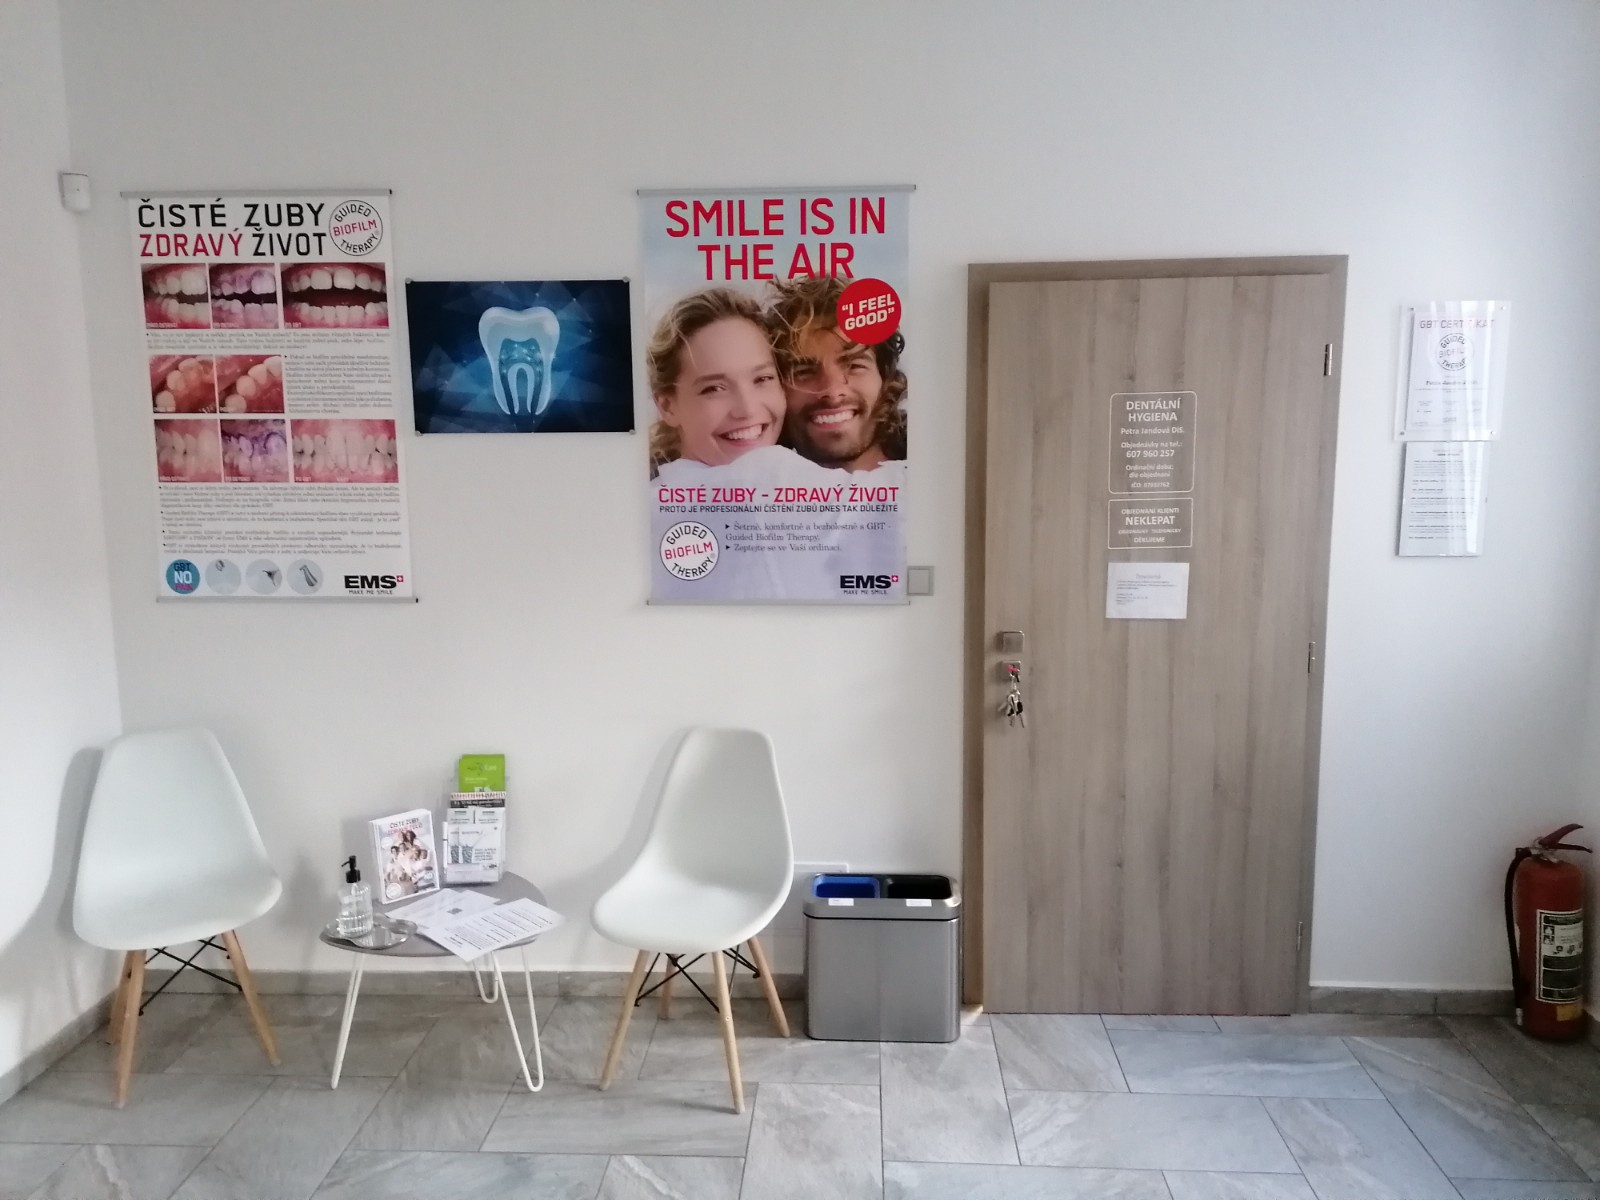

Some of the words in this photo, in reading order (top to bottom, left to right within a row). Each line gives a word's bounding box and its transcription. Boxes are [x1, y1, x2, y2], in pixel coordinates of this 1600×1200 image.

[138, 198, 227, 228] ČISTÉ
[243, 203, 325, 227] ZUBY
[334, 203, 372, 222] GUIDED
[665, 199, 785, 238] SMILE
[800, 197, 835, 236] IS
[849, 197, 886, 235] IN
[333, 219, 378, 237] BIOFILM
[139, 227, 243, 257] ZDRAVÝ
[251, 227, 327, 256] ŽIVOT
[340, 233, 379, 254] THERAPY
[697, 243, 775, 281] THE
[787, 242, 855, 280] AIR
[858, 293, 896, 313] FEEL
[1126, 397, 1182, 410] DENTÁLNÍ
[1128, 412, 1178, 422] HYGIENA
[1126, 450, 1141, 458] 607
[1160, 449, 1175, 457] 257
[658, 484, 707, 503] ČISTÉ
[711, 487, 757, 503] ZUBY
[773, 483, 844, 503] ZDRAVÝ
[848, 483, 900, 503] ŽIVOT
[659, 505, 687, 513] PROTO
[688, 505, 698, 513] JE
[819, 505, 841, 513] DNES
[842, 505, 858, 513] TAK
[866, 522, 886, 531] GBT
[1125, 515, 1176, 526] NEKLEPAT
[666, 525, 708, 545] GUIDED
[664, 541, 714, 560] BIOFILM
[671, 556, 714, 578] THERAPY
[174, 570, 193, 585] NO
[344, 575, 397, 589] EMS
[839, 574, 892, 589] EMS
